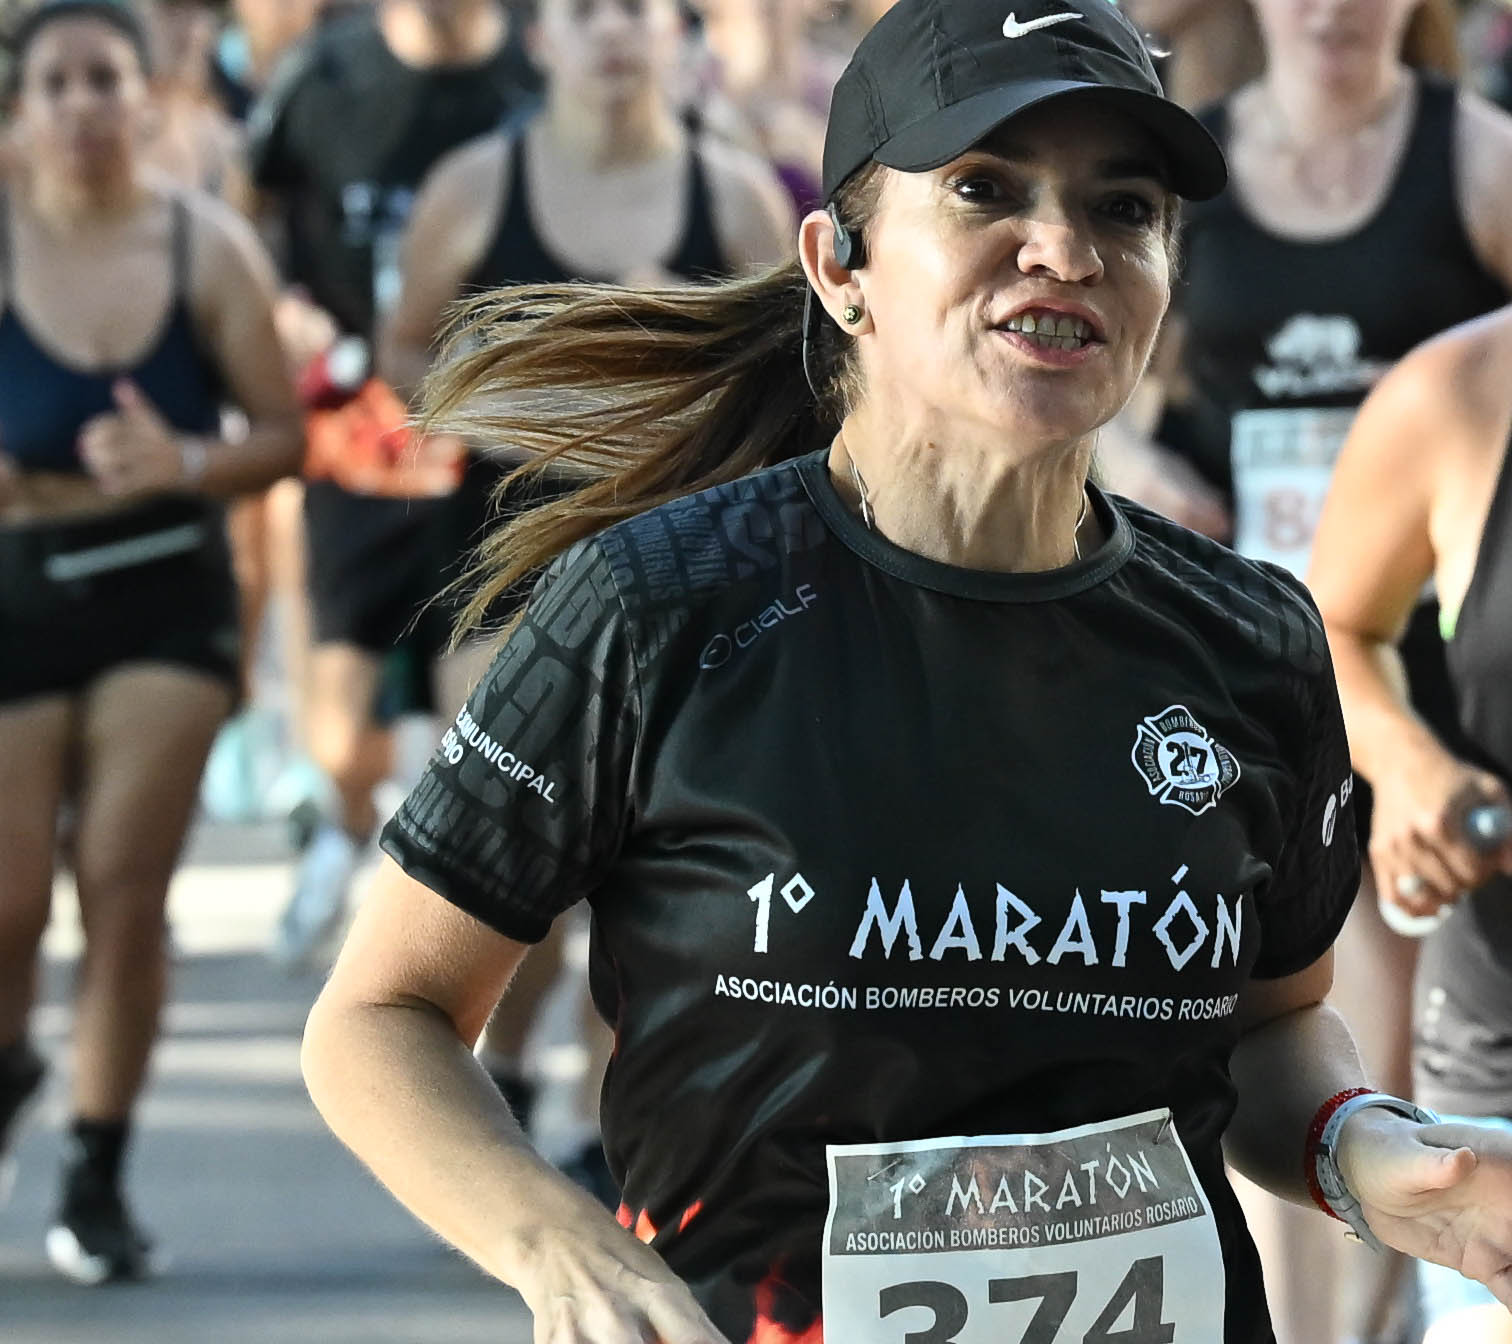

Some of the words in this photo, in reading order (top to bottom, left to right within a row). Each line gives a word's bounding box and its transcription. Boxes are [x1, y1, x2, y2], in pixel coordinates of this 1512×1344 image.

[1166, 741, 1208, 777] 27
[848, 863, 1244, 972] MARATÓN
[714, 973, 857, 1010] ASOCIACIÓN
[865, 986, 1000, 1010] BOMBEROS
[1008, 989, 1173, 1020] VOLUNTARIOS
[1177, 992, 1238, 1021] ROSARIO
[945, 1142, 1161, 1217] MARATÓN
[845, 1228, 946, 1252] ASOCIACIÓN
[950, 1224, 1041, 1248] BOMBEROS
[1044, 1210, 1143, 1242] VOLUNTARIOS
[1145, 1196, 1200, 1224] ROSARIO
